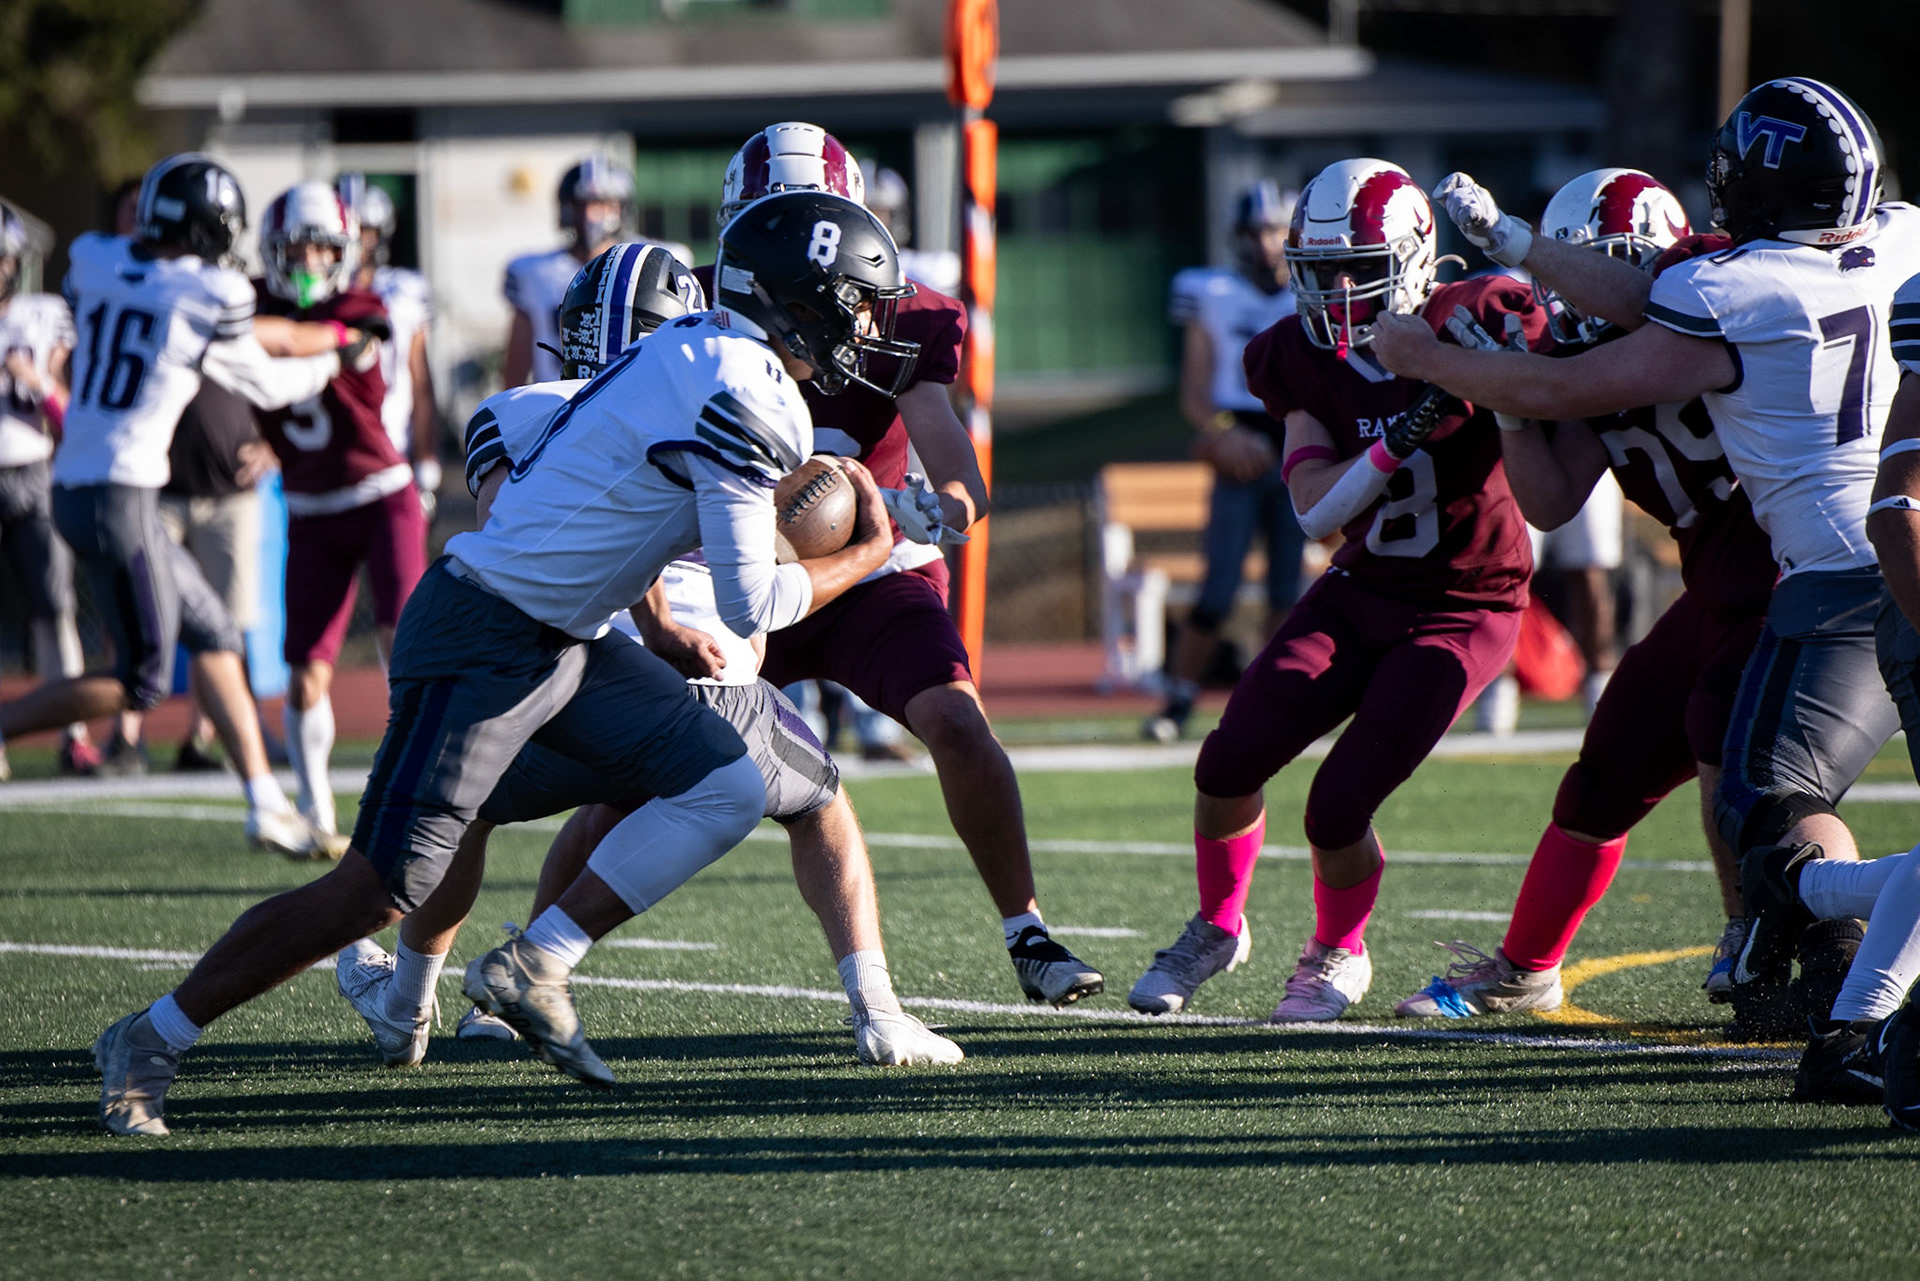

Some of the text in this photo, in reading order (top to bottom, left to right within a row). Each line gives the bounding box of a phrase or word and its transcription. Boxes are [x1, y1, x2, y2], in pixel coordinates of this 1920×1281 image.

[1737, 110, 1808, 170] VT
[807, 220, 842, 268] 8
[80, 301, 157, 411] 16
[1816, 303, 1879, 447] 7
[1365, 447, 1440, 559] 8
